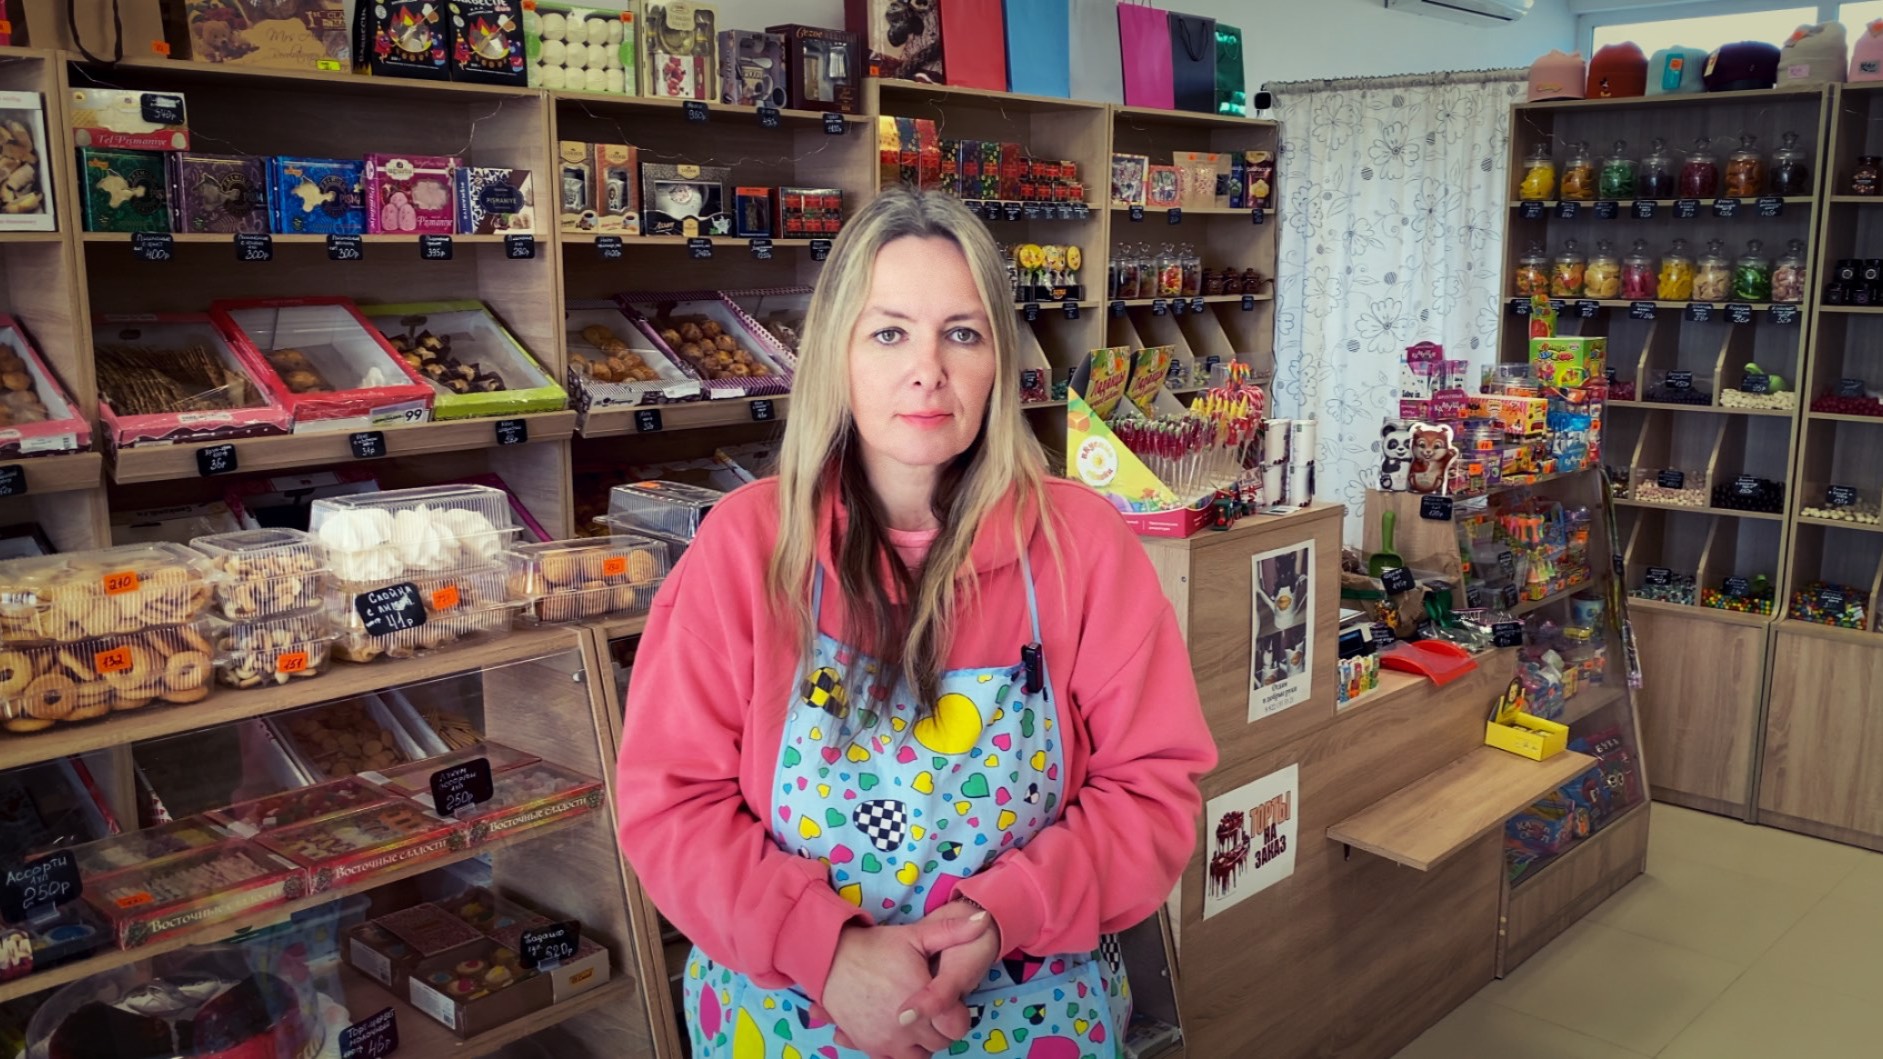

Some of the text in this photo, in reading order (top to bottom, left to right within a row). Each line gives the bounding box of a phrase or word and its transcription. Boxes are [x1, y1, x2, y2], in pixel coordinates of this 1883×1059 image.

[405, 408, 423, 422] 99
[108, 577, 131, 591] 210
[446, 790, 474, 810] 250р
[489, 797, 588, 832] Восточные сладости
[1250, 790, 1292, 839] ТОРТЫ
[1263, 822, 1277, 846] НА
[335, 839, 448, 880] Восточные сладости
[1254, 834, 1287, 869] ЗАКАЗ
[22, 880, 71, 910] 250р
[368, 1034, 392, 1057] 46р
